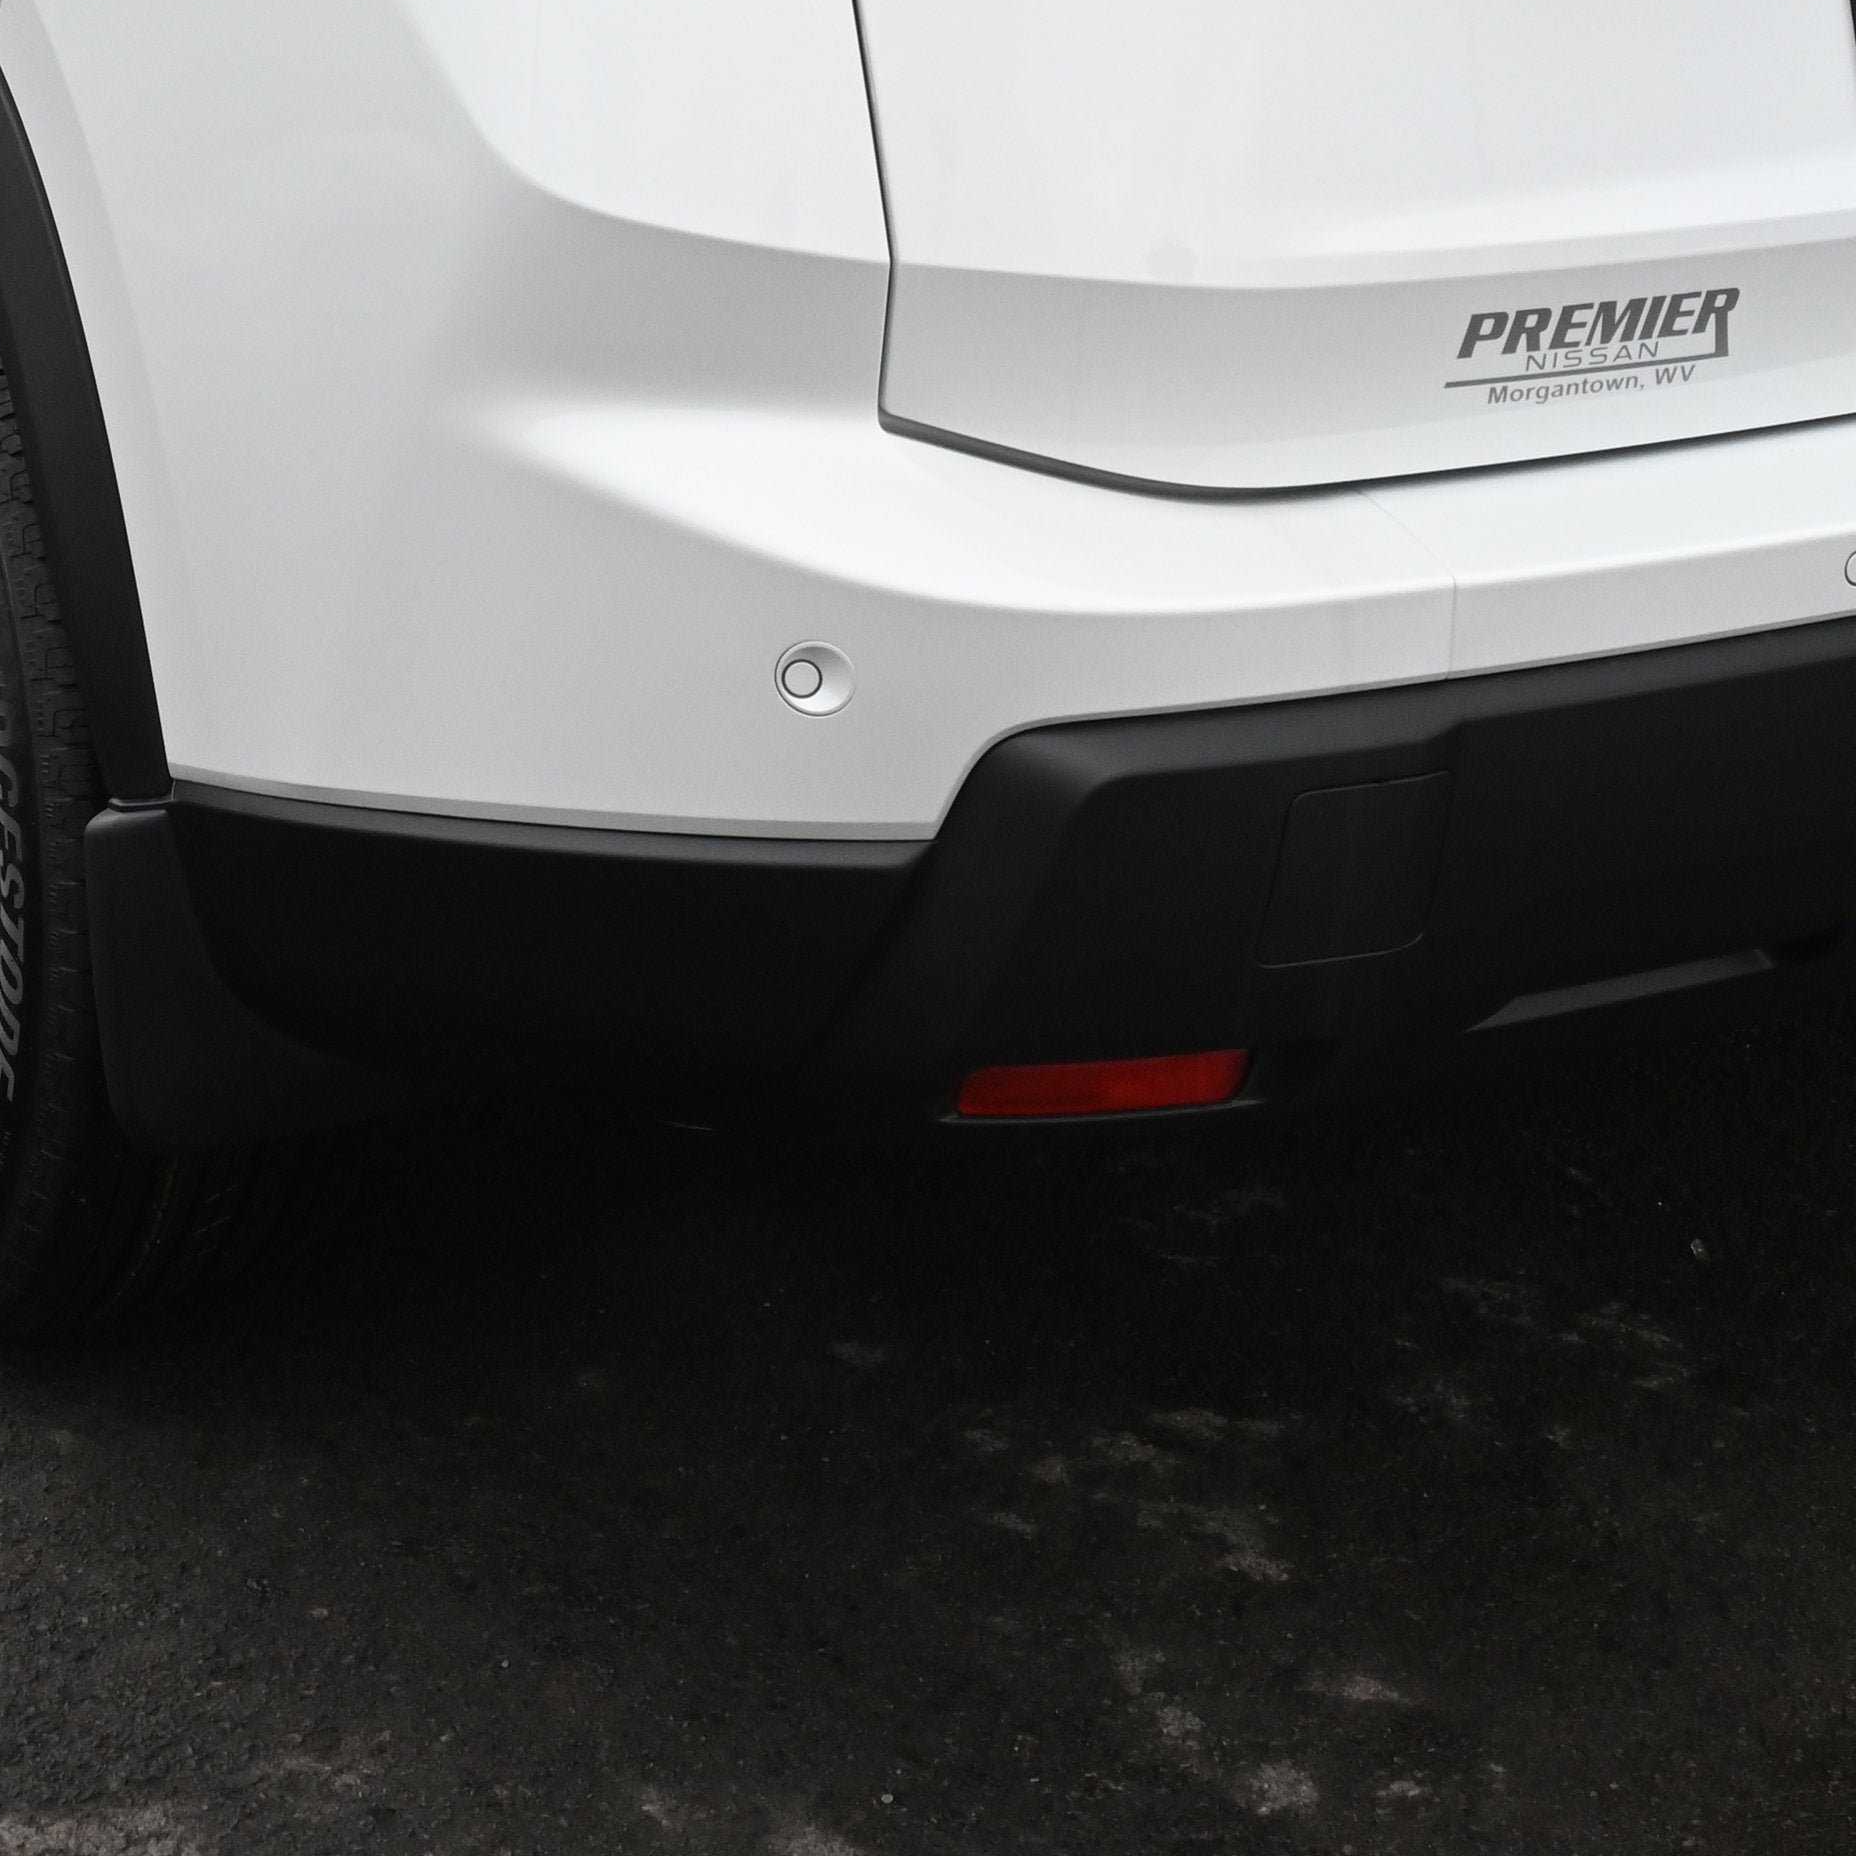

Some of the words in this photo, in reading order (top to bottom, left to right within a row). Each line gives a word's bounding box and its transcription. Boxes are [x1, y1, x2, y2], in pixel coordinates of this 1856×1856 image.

[1456, 287, 1740, 360] PREMIER
[1526, 341, 1660, 372] NISSAN
[1487, 375, 1645, 405] Morgantown,
[1655, 364, 1697, 386] WV
